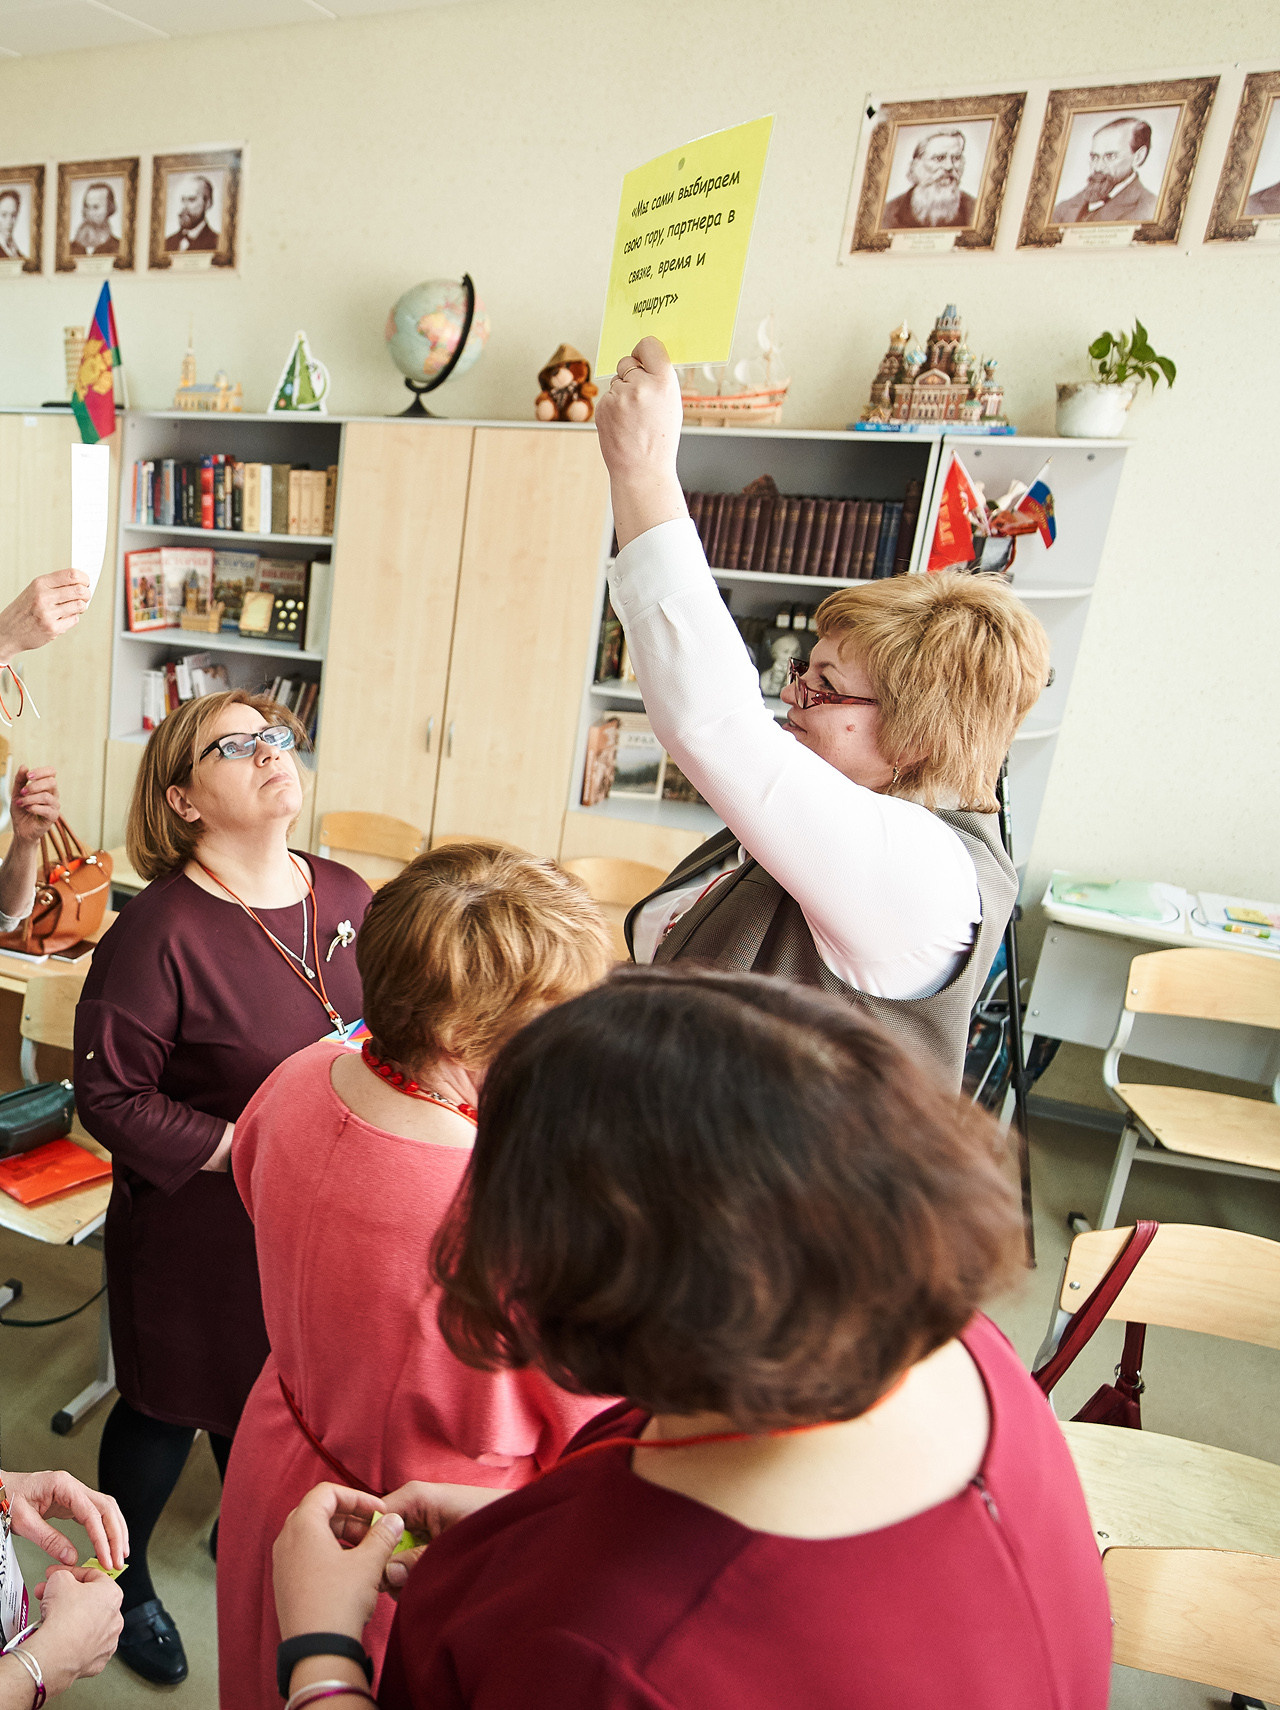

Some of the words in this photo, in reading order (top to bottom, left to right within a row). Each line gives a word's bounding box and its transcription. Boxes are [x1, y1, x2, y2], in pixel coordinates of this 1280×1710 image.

[631, 199, 650, 218] «Мы
[651, 191, 675, 211] сами
[677, 170, 740, 201] выбираем
[623, 235, 643, 255] свою
[644, 227, 665, 249] гору,
[666, 212, 722, 240] партнера
[727, 209, 736, 224] в
[628, 264, 654, 284] связке,
[657, 254, 692, 279] время
[696, 252, 707, 267] и
[632, 292, 679, 318] маршрут»
